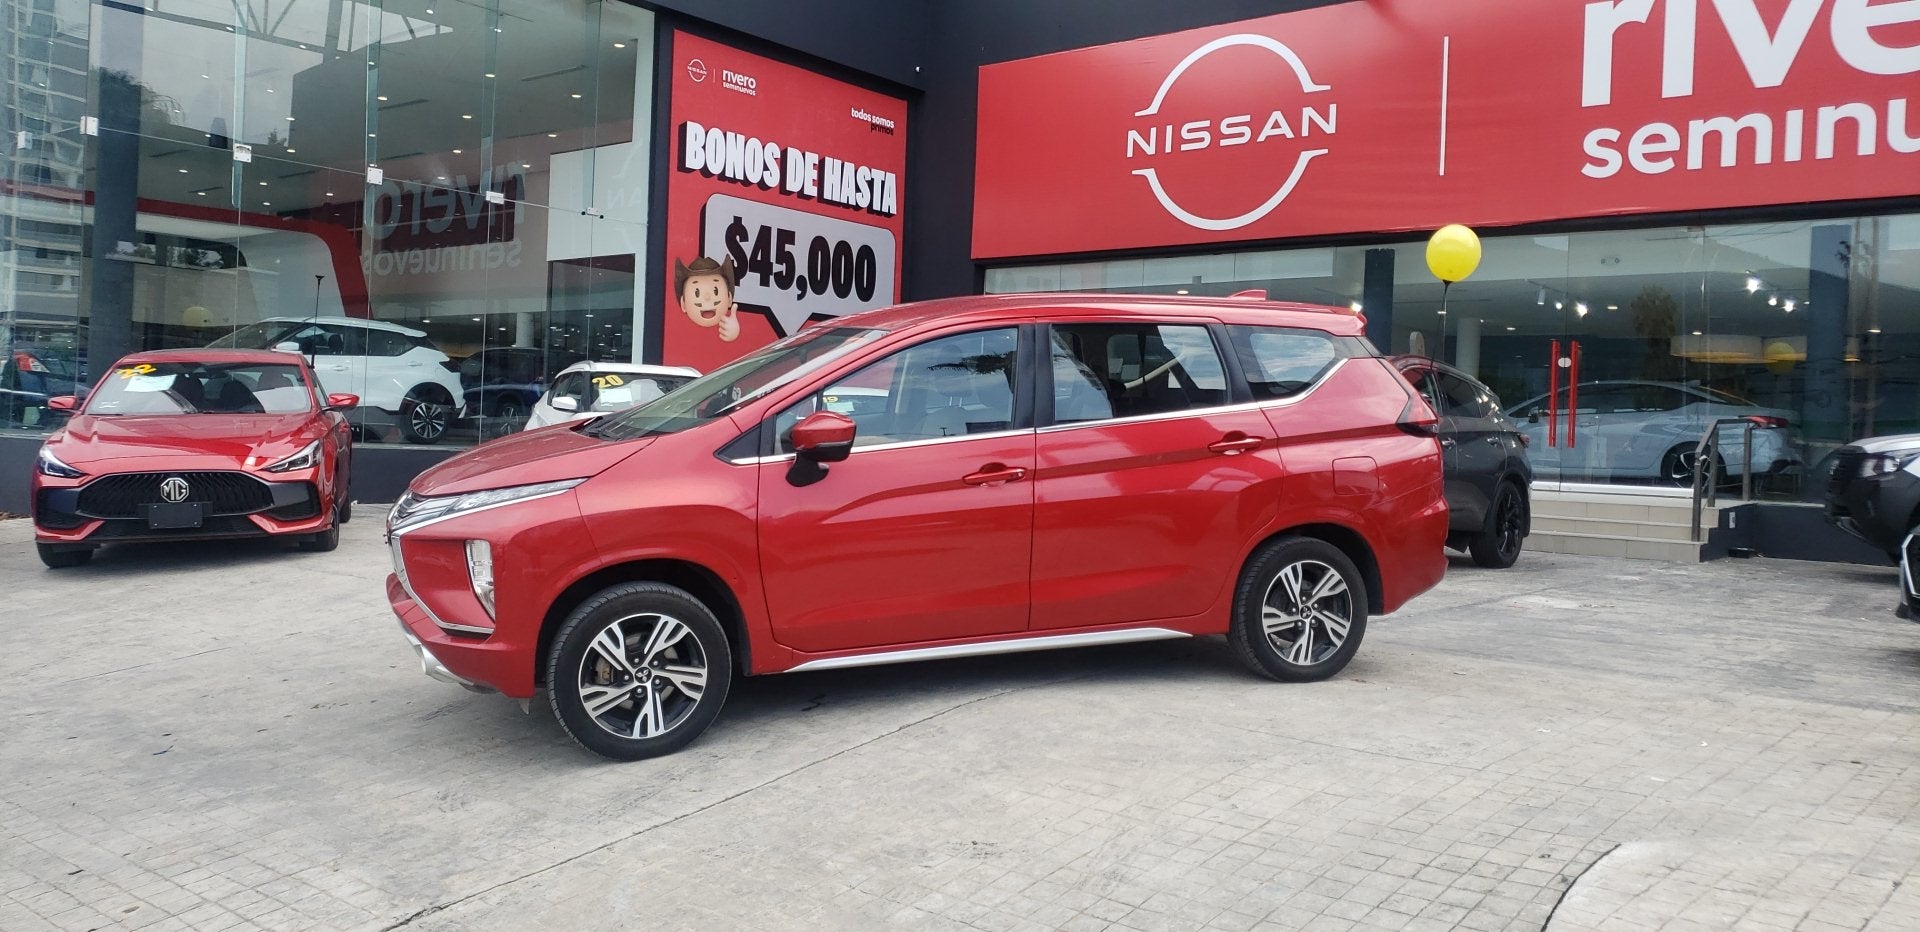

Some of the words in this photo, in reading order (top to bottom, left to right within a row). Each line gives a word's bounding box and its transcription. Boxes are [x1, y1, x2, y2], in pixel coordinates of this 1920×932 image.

[722, 69, 756, 89] rivero
[851, 107, 872, 122] todos
[871, 115, 895, 129] somos
[1126, 103, 1337, 158] NISSAN
[681, 121, 781, 191] BONOS
[781, 147, 819, 199] DE
[819, 157, 897, 217] HASTA
[724, 215, 877, 303] $45,000
[592, 374, 624, 389] 20
[163, 480, 187, 501] MG
